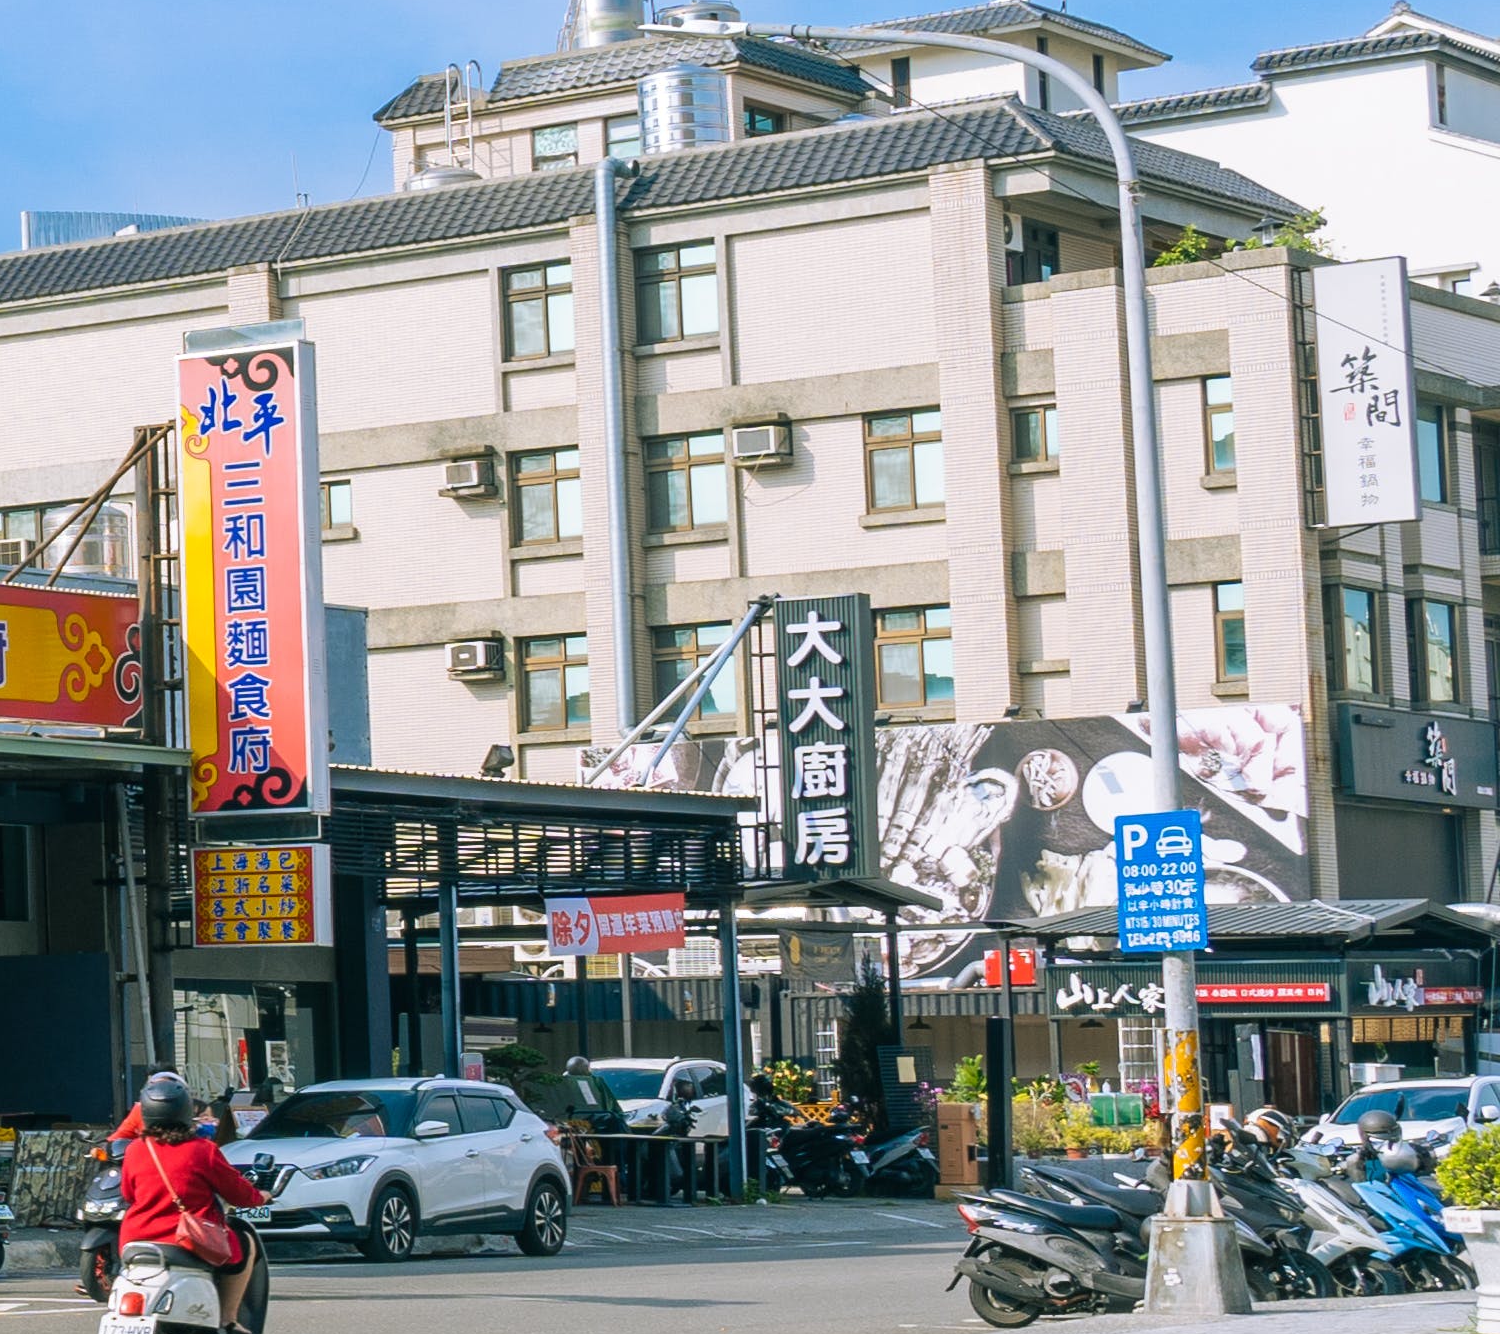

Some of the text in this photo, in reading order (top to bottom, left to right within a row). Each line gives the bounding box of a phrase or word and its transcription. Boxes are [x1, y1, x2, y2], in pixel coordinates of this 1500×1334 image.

[1329, 345, 1402, 427] 築間
[1357, 437, 1380, 507] 幸福鍋物
[199, 376, 286, 776] 北平三和園麵食府
[786, 610, 850, 866] 大大廚房
[210, 851, 296, 872] 上海湯包
[1123, 824, 1148, 860] P
[210, 873, 296, 895] 江浙名菜
[210, 897, 296, 917] 各式小炒
[210, 920, 297, 942] 宴會聚餐
[551, 909, 592, 948] 除夕
[1055, 971, 1166, 1014] 山上人家
